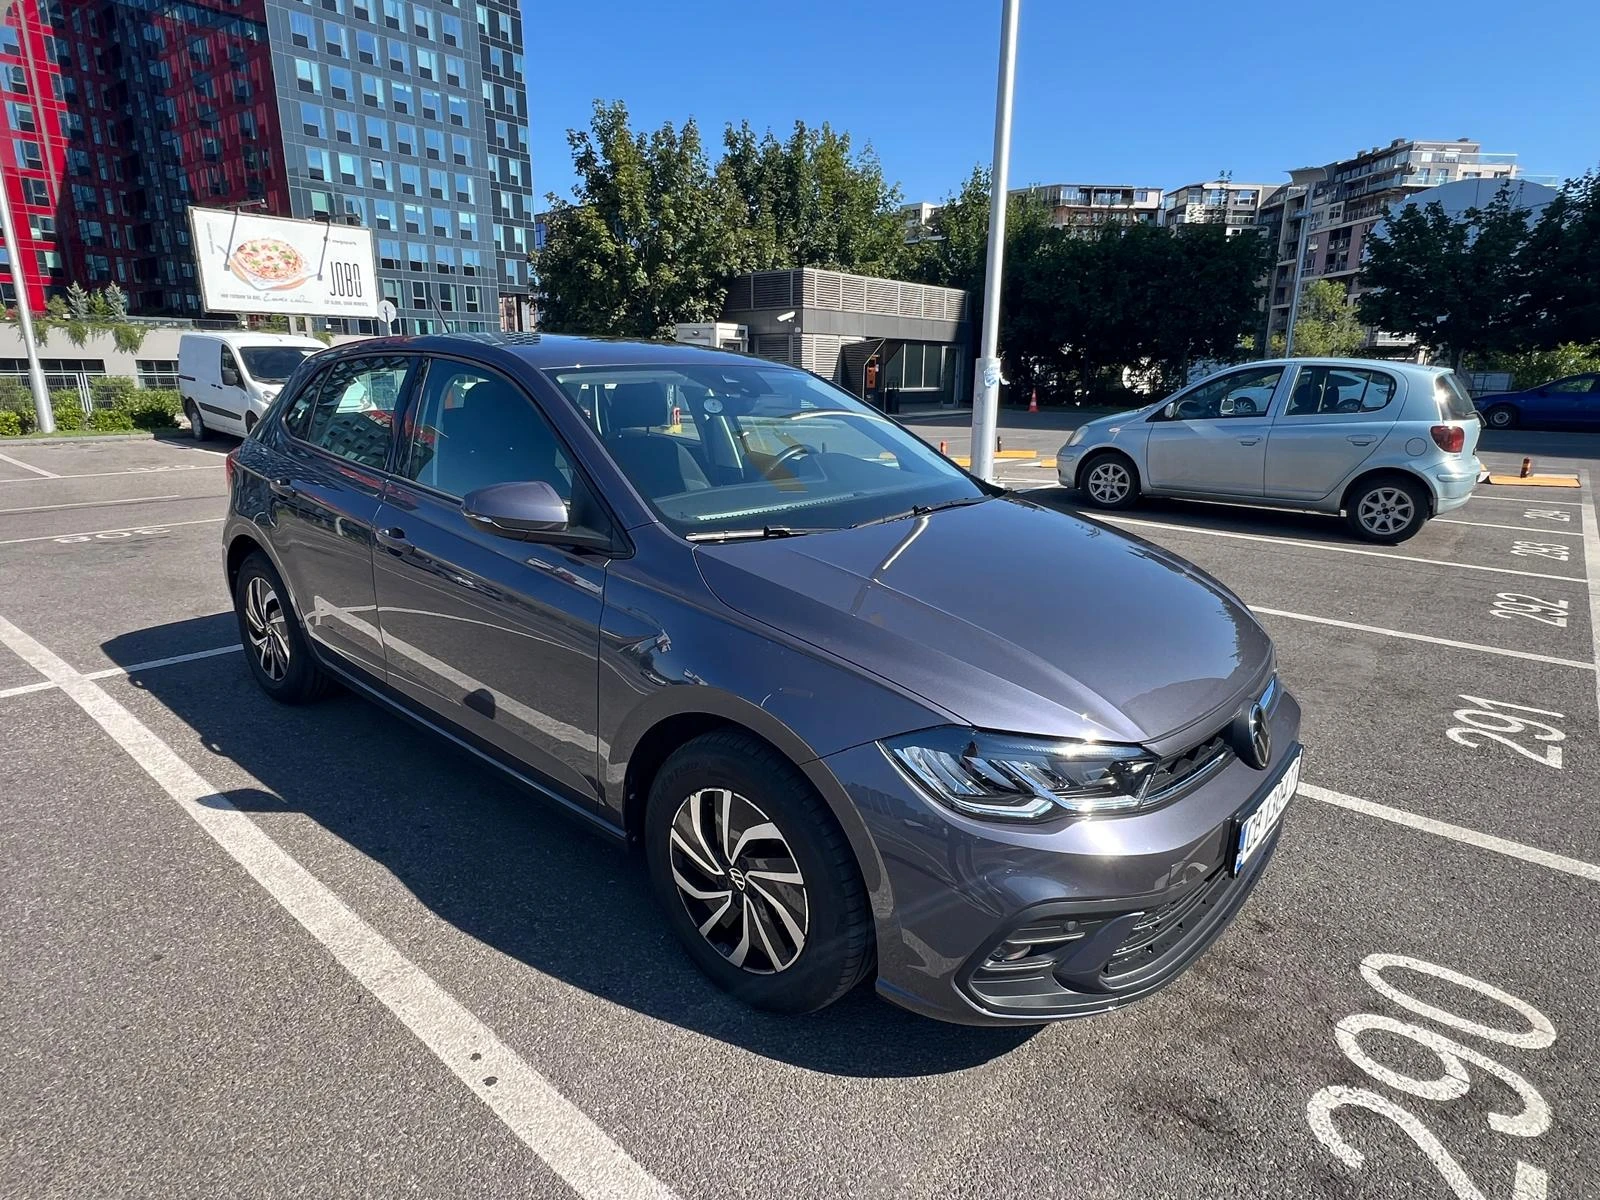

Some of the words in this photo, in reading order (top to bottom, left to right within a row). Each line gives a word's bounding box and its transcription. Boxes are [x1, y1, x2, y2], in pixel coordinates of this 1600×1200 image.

[329, 261, 362, 298] JOBO
[1510, 540, 1570, 562] 293
[1489, 592, 1569, 628] 292
[1445, 694, 1567, 770] 291
[1306, 953, 1557, 1200] 290
